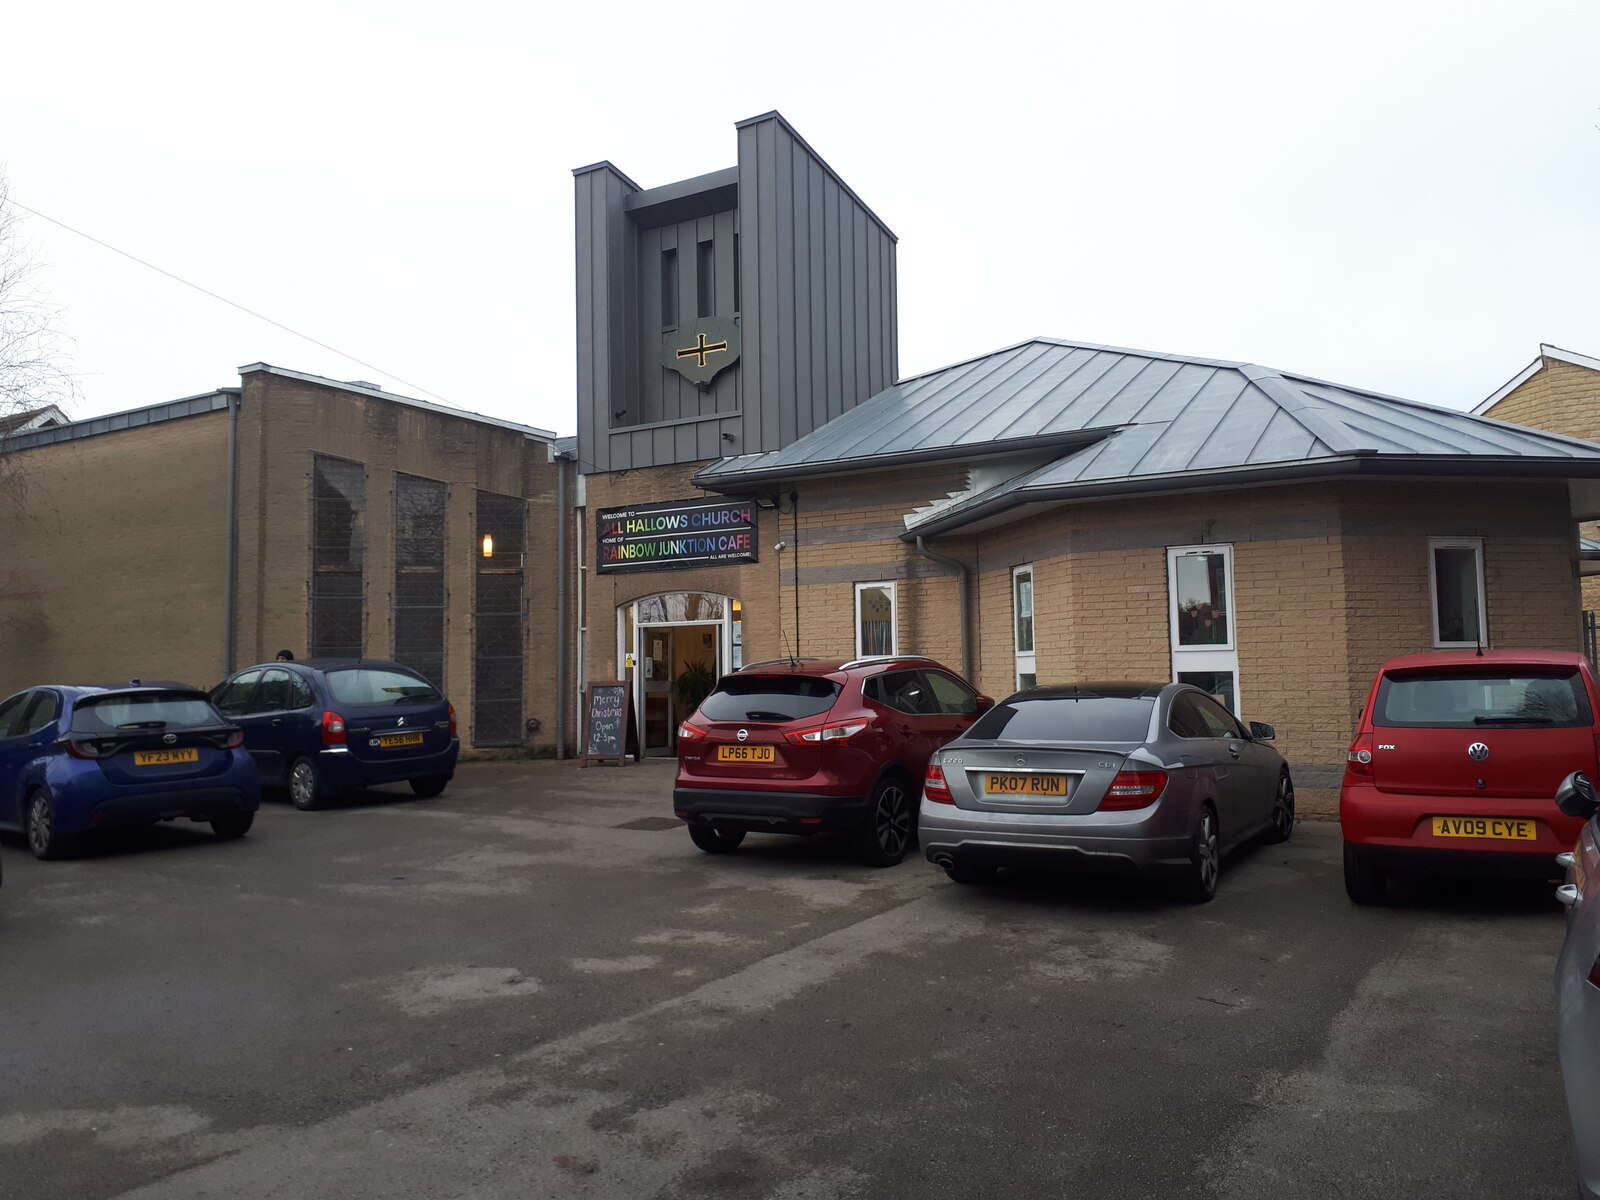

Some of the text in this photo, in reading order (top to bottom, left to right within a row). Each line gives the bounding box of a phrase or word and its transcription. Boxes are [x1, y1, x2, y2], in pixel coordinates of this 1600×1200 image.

[602, 508, 751, 535] ALL HALLOWS CHURCH
[602, 534, 750, 560] RAINBOW JUNKTION CAFE
[593, 696, 620, 708] Merry
[592, 708, 622, 718] Christmas
[595, 721, 614, 733] Open
[140, 752, 170, 762] YF23
[722, 748, 770, 760] LP66 TJO
[990, 776, 1060, 792] PK07 RUN
[1440, 820, 1528, 838] AV09 CYE
